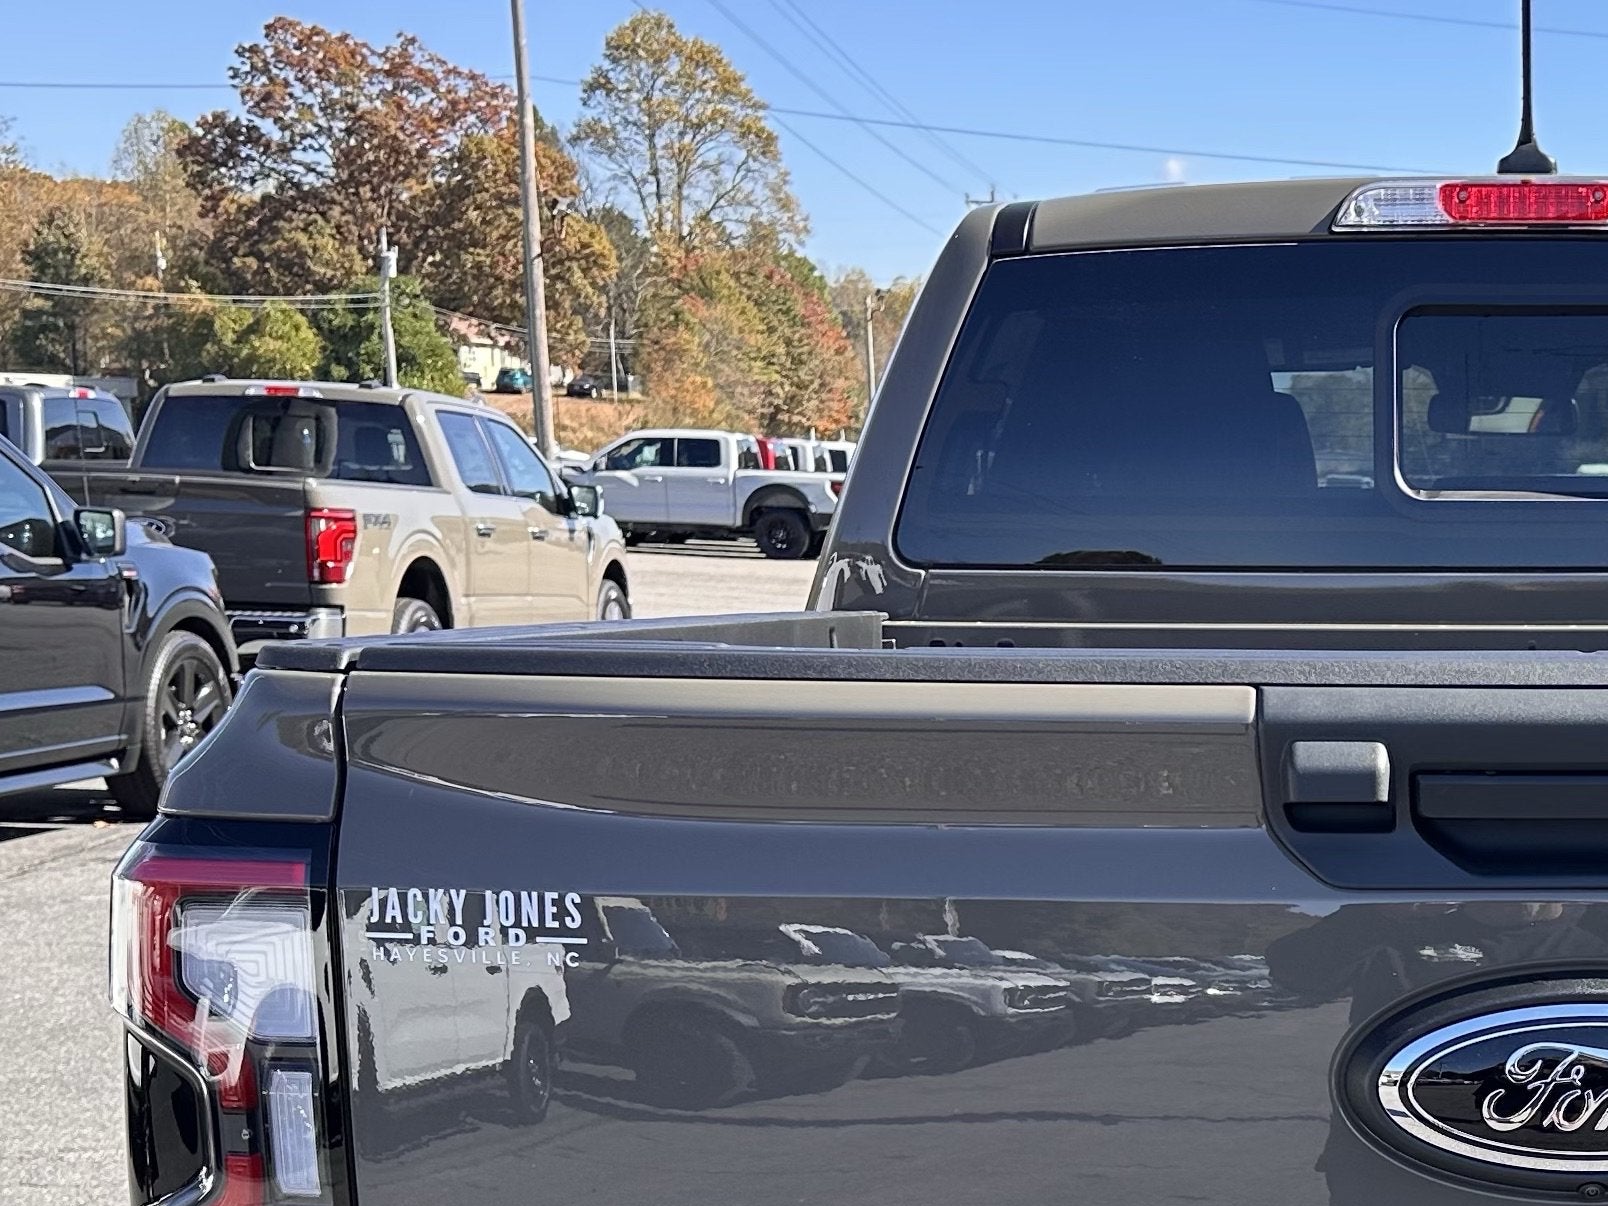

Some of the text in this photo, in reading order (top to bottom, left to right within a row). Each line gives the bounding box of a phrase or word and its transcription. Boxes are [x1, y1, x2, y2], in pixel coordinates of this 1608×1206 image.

[370, 887, 582, 929] JACKY JONES
[420, 925, 527, 947] FORD
[372, 946, 580, 968] HAYESVILLE, NC
